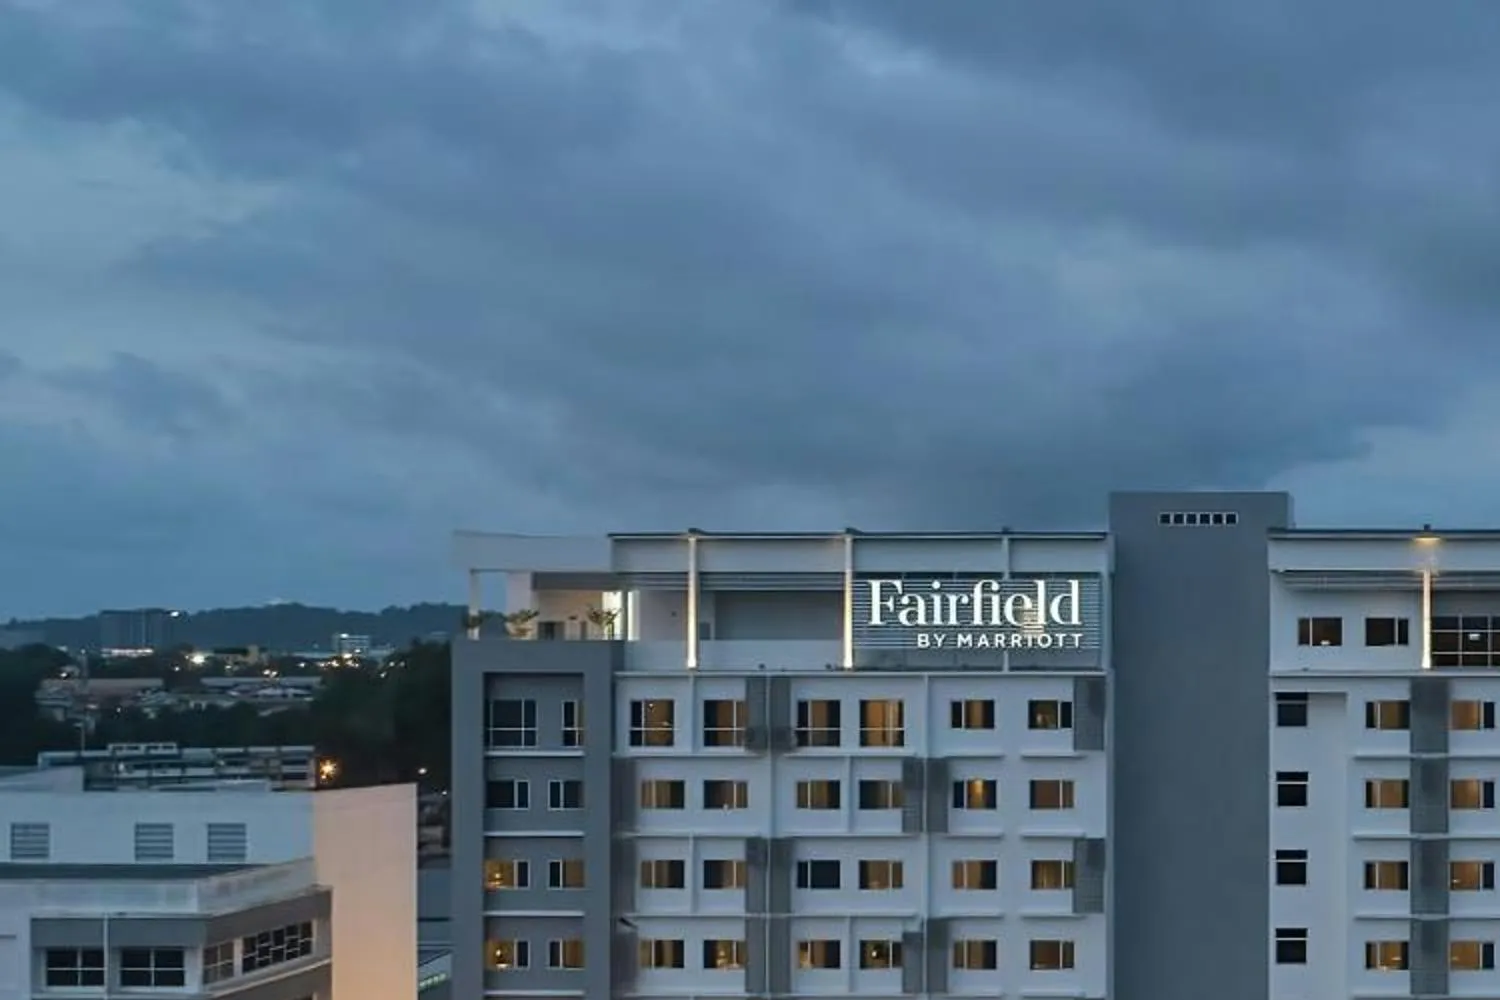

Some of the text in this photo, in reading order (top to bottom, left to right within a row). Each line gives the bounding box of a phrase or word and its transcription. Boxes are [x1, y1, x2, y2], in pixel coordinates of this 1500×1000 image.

[868, 579, 1082, 626] Fairfield
[917, 633, 1083, 648] BY MARRIOTT
